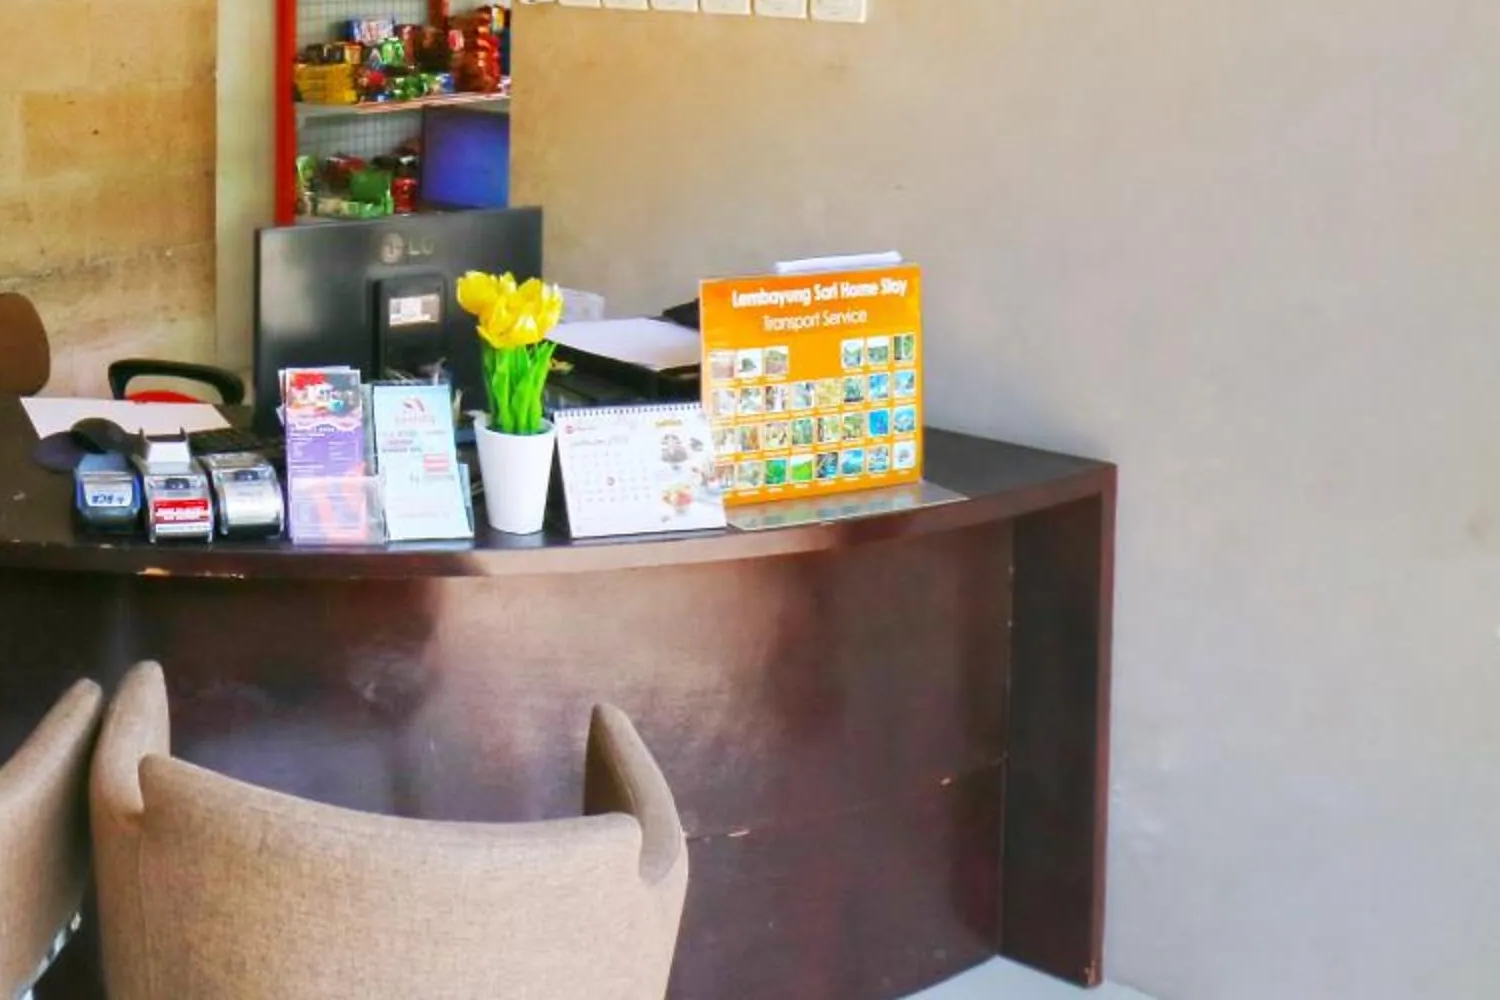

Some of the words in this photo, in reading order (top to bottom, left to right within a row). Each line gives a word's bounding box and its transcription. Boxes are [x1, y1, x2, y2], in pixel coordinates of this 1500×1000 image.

[732, 288, 812, 308] Lembayung
[813, 282, 838, 301] Sari
[840, 281, 878, 299] Home
[880, 277, 907, 297] Stay
[763, 312, 820, 333] Transport
[822, 309, 868, 327] Service
